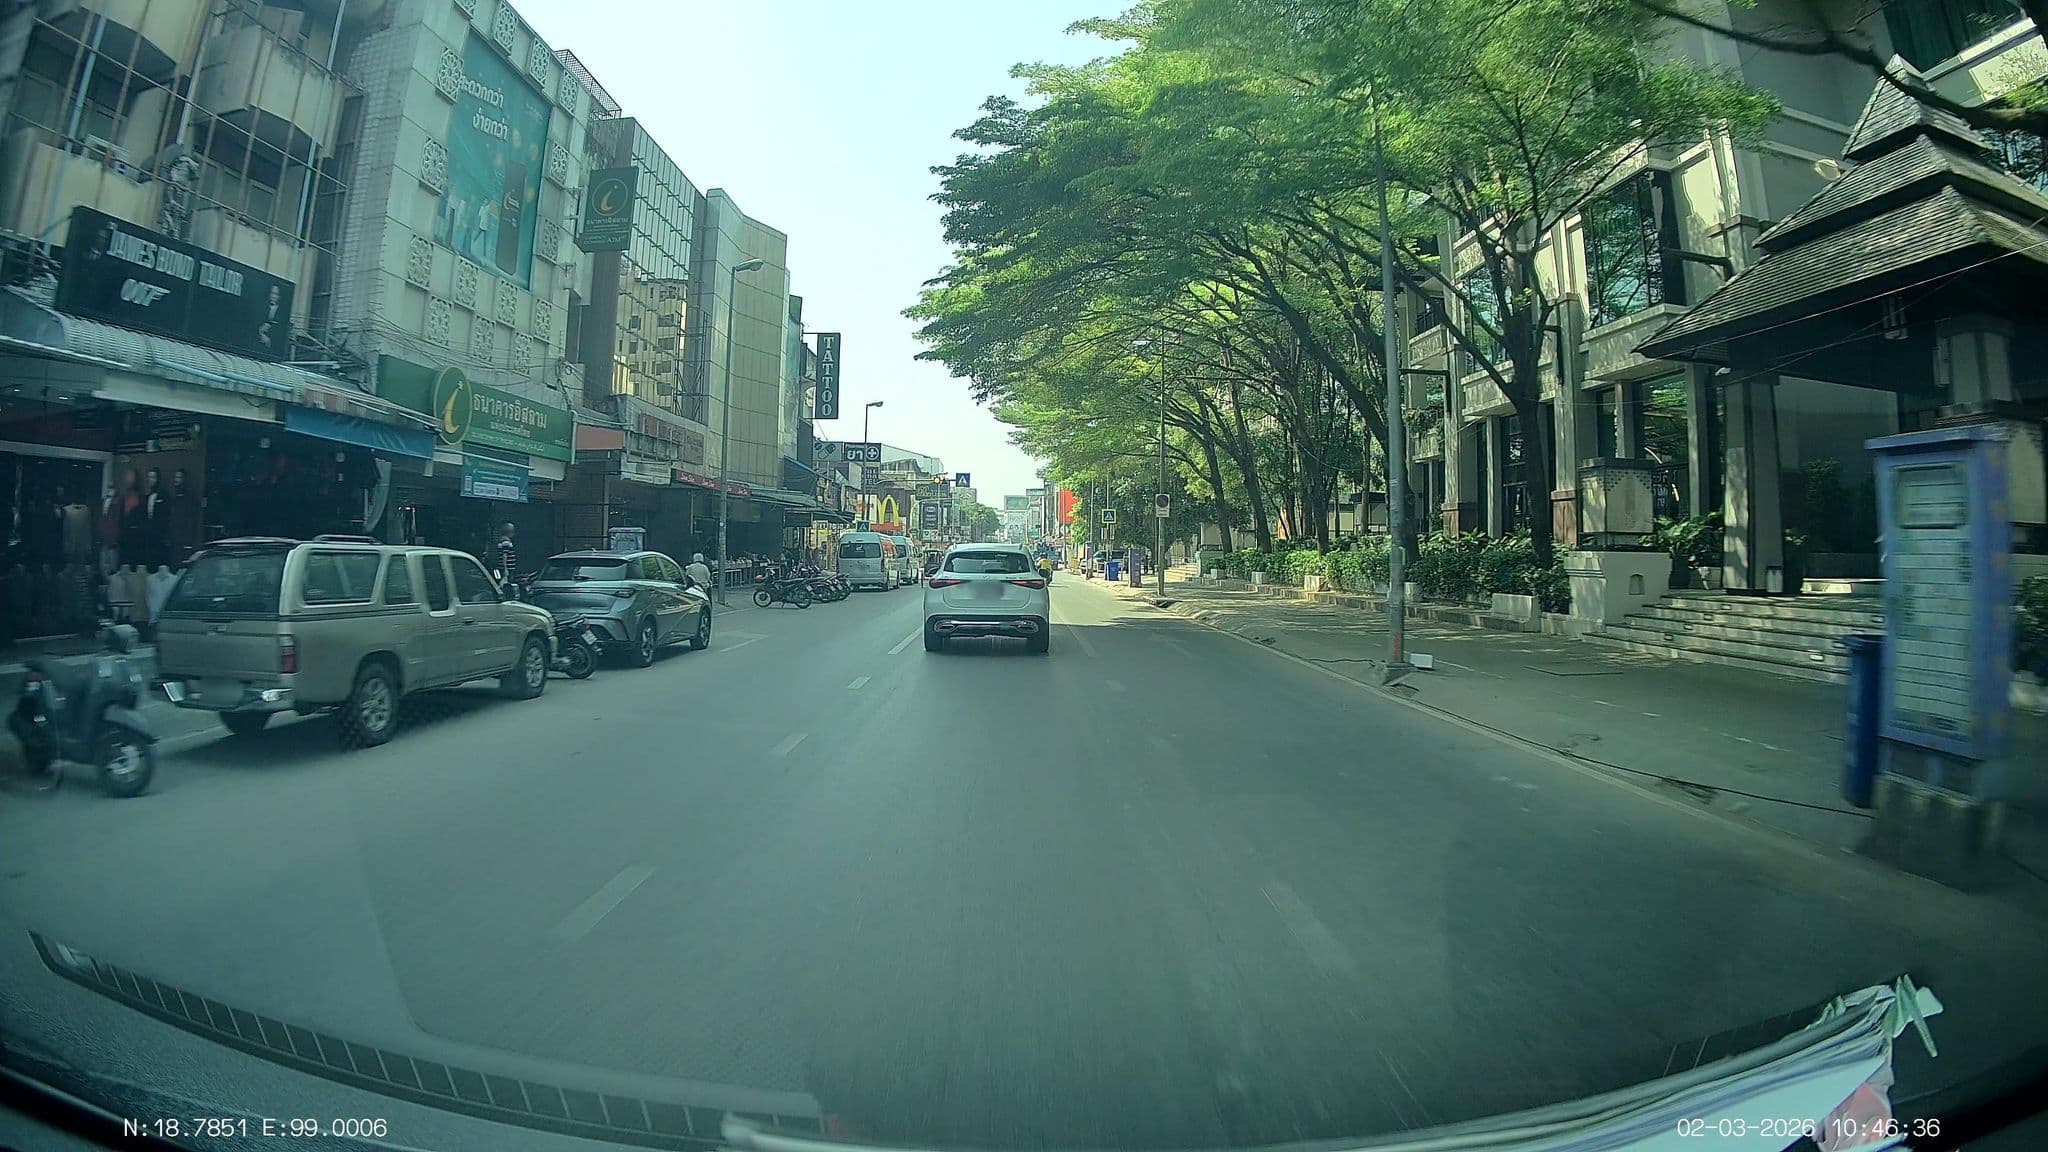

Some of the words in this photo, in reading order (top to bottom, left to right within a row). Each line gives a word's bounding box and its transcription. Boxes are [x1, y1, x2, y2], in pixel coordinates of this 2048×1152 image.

[472, 107, 508, 140] ง่ายกว่า
[106, 228, 158, 269] JAMES
[155, 246, 195, 281] BOND
[199, 260, 244, 297] TAILOR
[821, 336, 834, 416] TATTOO
[473, 393, 548, 429] ธนาคารอิสลาม
[847, 450, 863, 460] ยา
